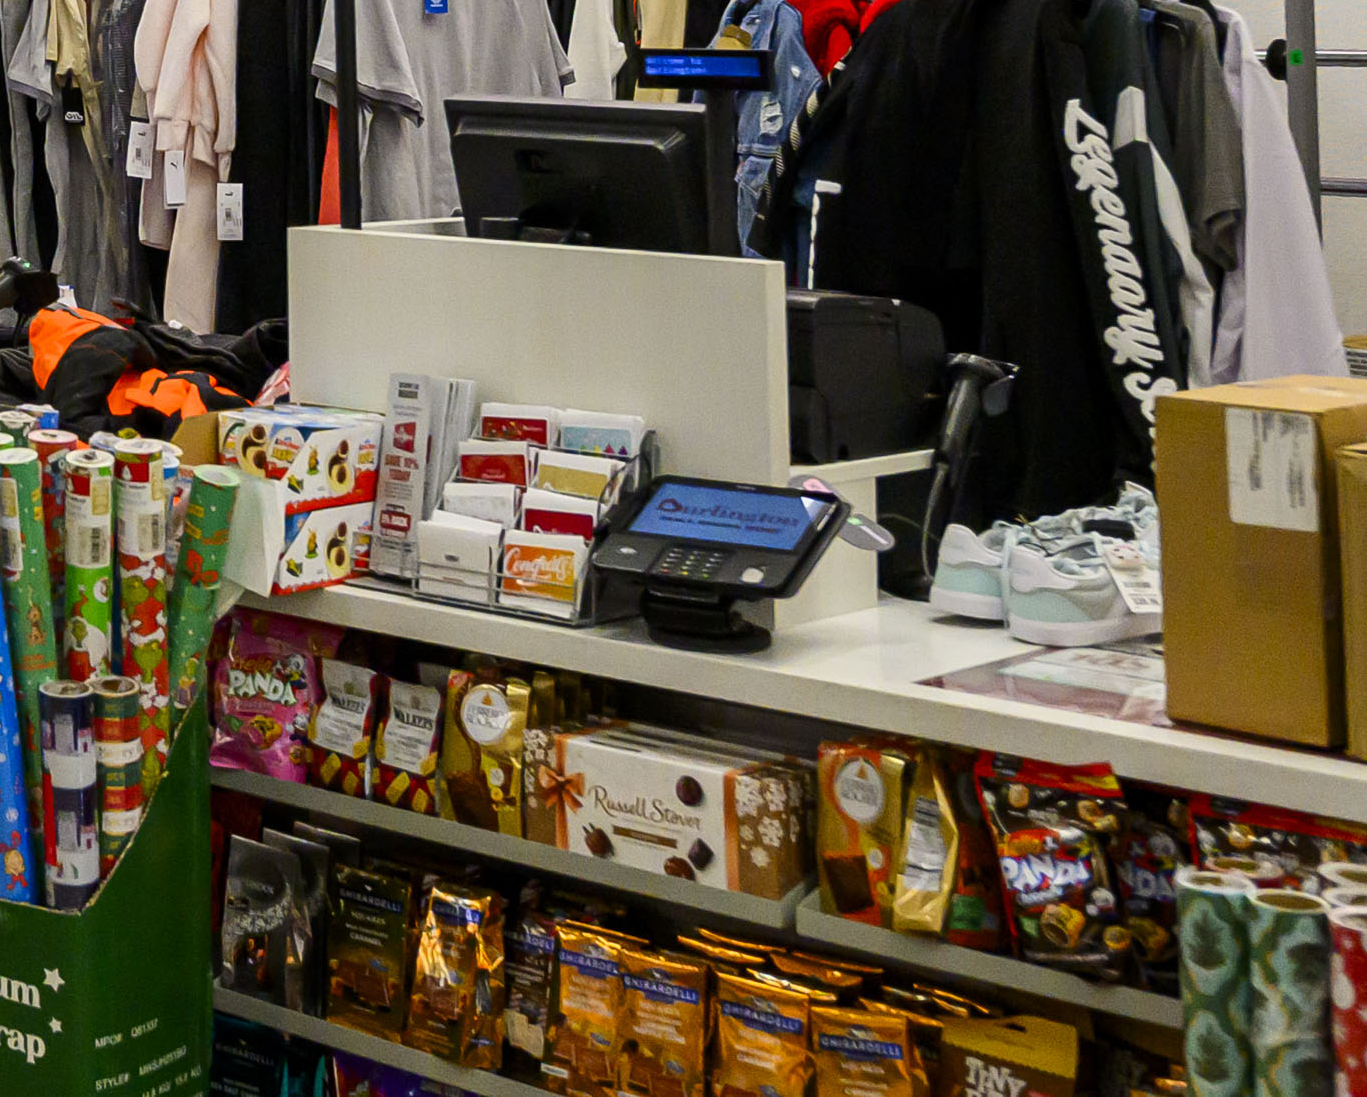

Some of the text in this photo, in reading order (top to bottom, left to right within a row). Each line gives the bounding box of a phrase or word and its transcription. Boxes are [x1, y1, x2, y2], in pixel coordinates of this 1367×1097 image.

[1063, 98, 1165, 370] Legendary
[657, 498, 799, 528] Burlington
[227, 669, 299, 706] PANDA
[392, 706, 435, 730] WALKERS
[589, 784, 702, 831] Russell Stover
[999, 854, 1092, 892] PANDA
[339, 887, 403, 914] GHIRARDELLI
[623, 973, 698, 1003] GHIRARDELLI
[722, 1004, 803, 1034] GHIRARDELLI
[820, 1035, 903, 1059] GHIRARDELLI
